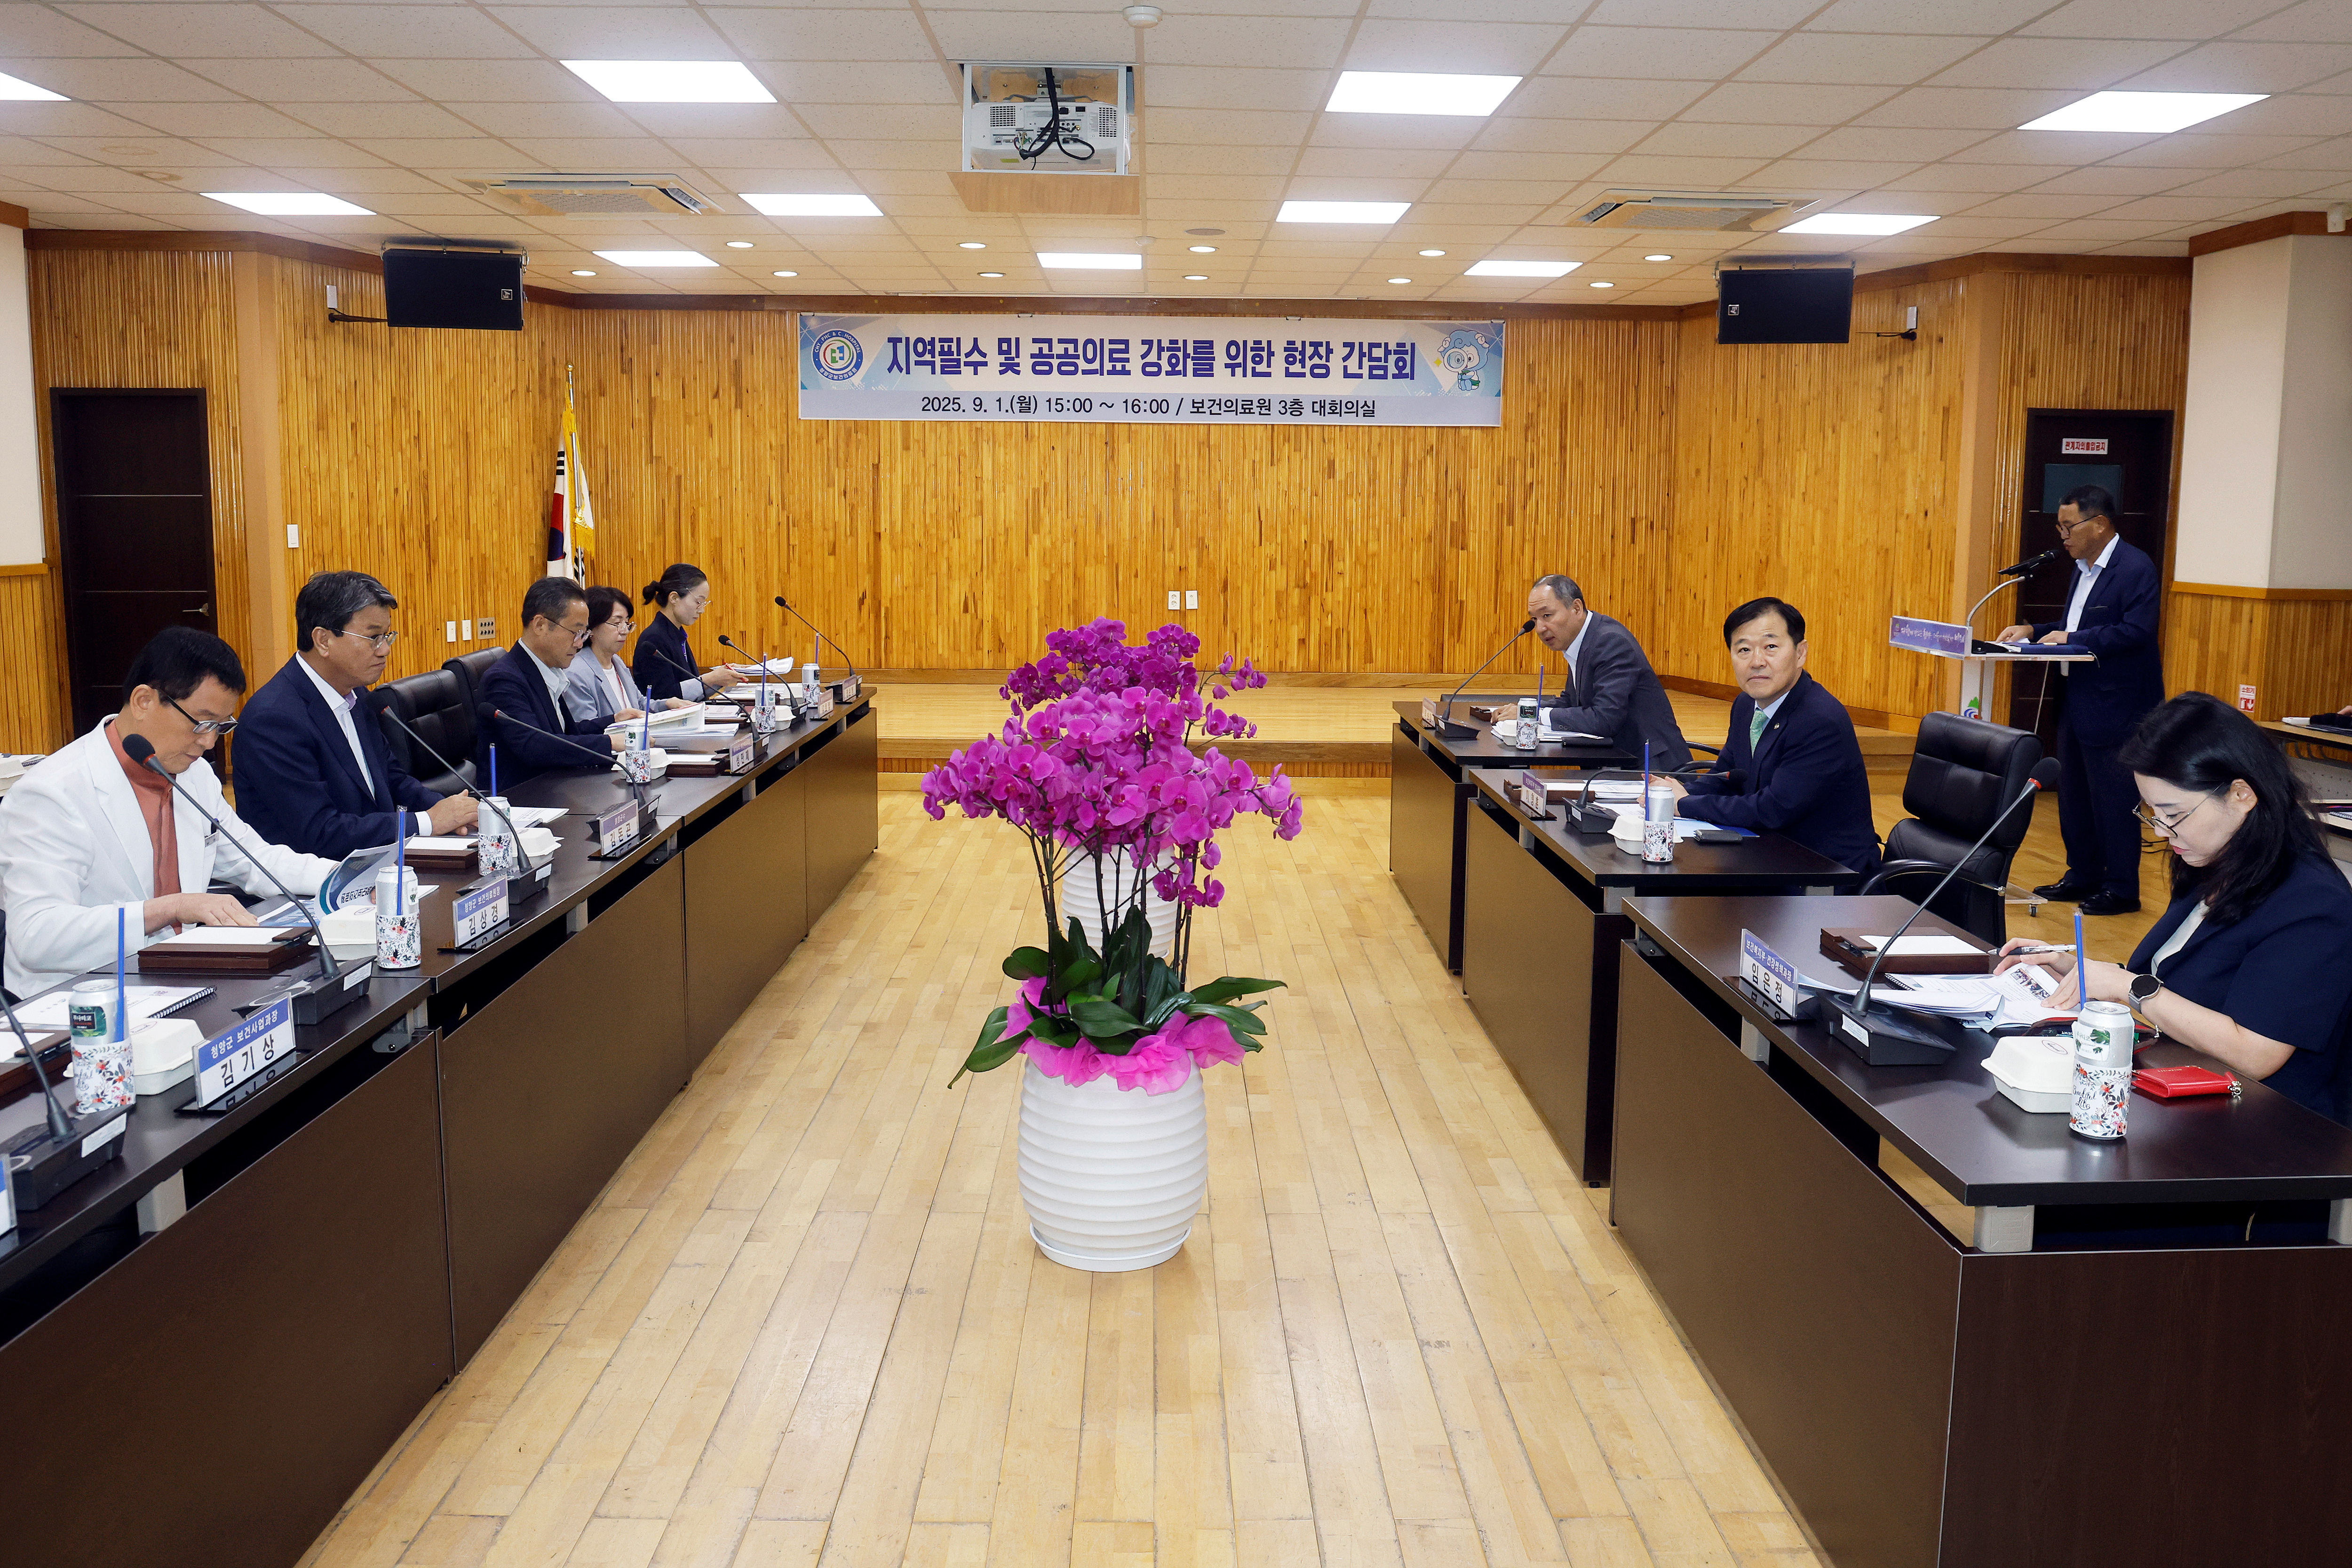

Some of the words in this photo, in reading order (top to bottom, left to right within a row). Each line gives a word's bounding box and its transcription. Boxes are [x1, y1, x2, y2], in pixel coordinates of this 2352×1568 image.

[844, 333, 861, 354] HOSPITAL
[887, 336, 988, 376] 지역필수
[997, 337, 1021, 375] 및
[1030, 337, 1131, 376] 공공의료
[1140, 338, 1216, 377] 강화를
[1224, 340, 1275, 378] 위한
[1283, 340, 1334, 379] 현장
[1342, 341, 1416, 380] 간담회
[922, 396, 966, 413] 2025.
[973, 396, 988, 413] 9.
[1046, 398, 1093, 413] 15:00
[1122, 398, 1170, 414] 16:00
[1176, 397, 1184, 416] /
[1190, 398, 1271, 416] 보건의료원
[1278, 399, 1304, 417] 3층
[1311, 399, 1376, 418] 대회의실
[464, 899, 476, 913] 청양군
[478, 886, 501, 905] 보건의료원장
[469, 903, 498, 936] 김상경
[1746, 940, 1766, 961] 보건복지부
[1767, 955, 1792, 982] 건강정책과장
[1752, 963, 1782, 1004] 임은정
[211, 1036, 233, 1059] 청양군
[237, 1009, 278, 1043] 보건사업과장
[221, 1034, 274, 1088] 김기상
[2073, 1084, 2097, 1100] Beautiful
